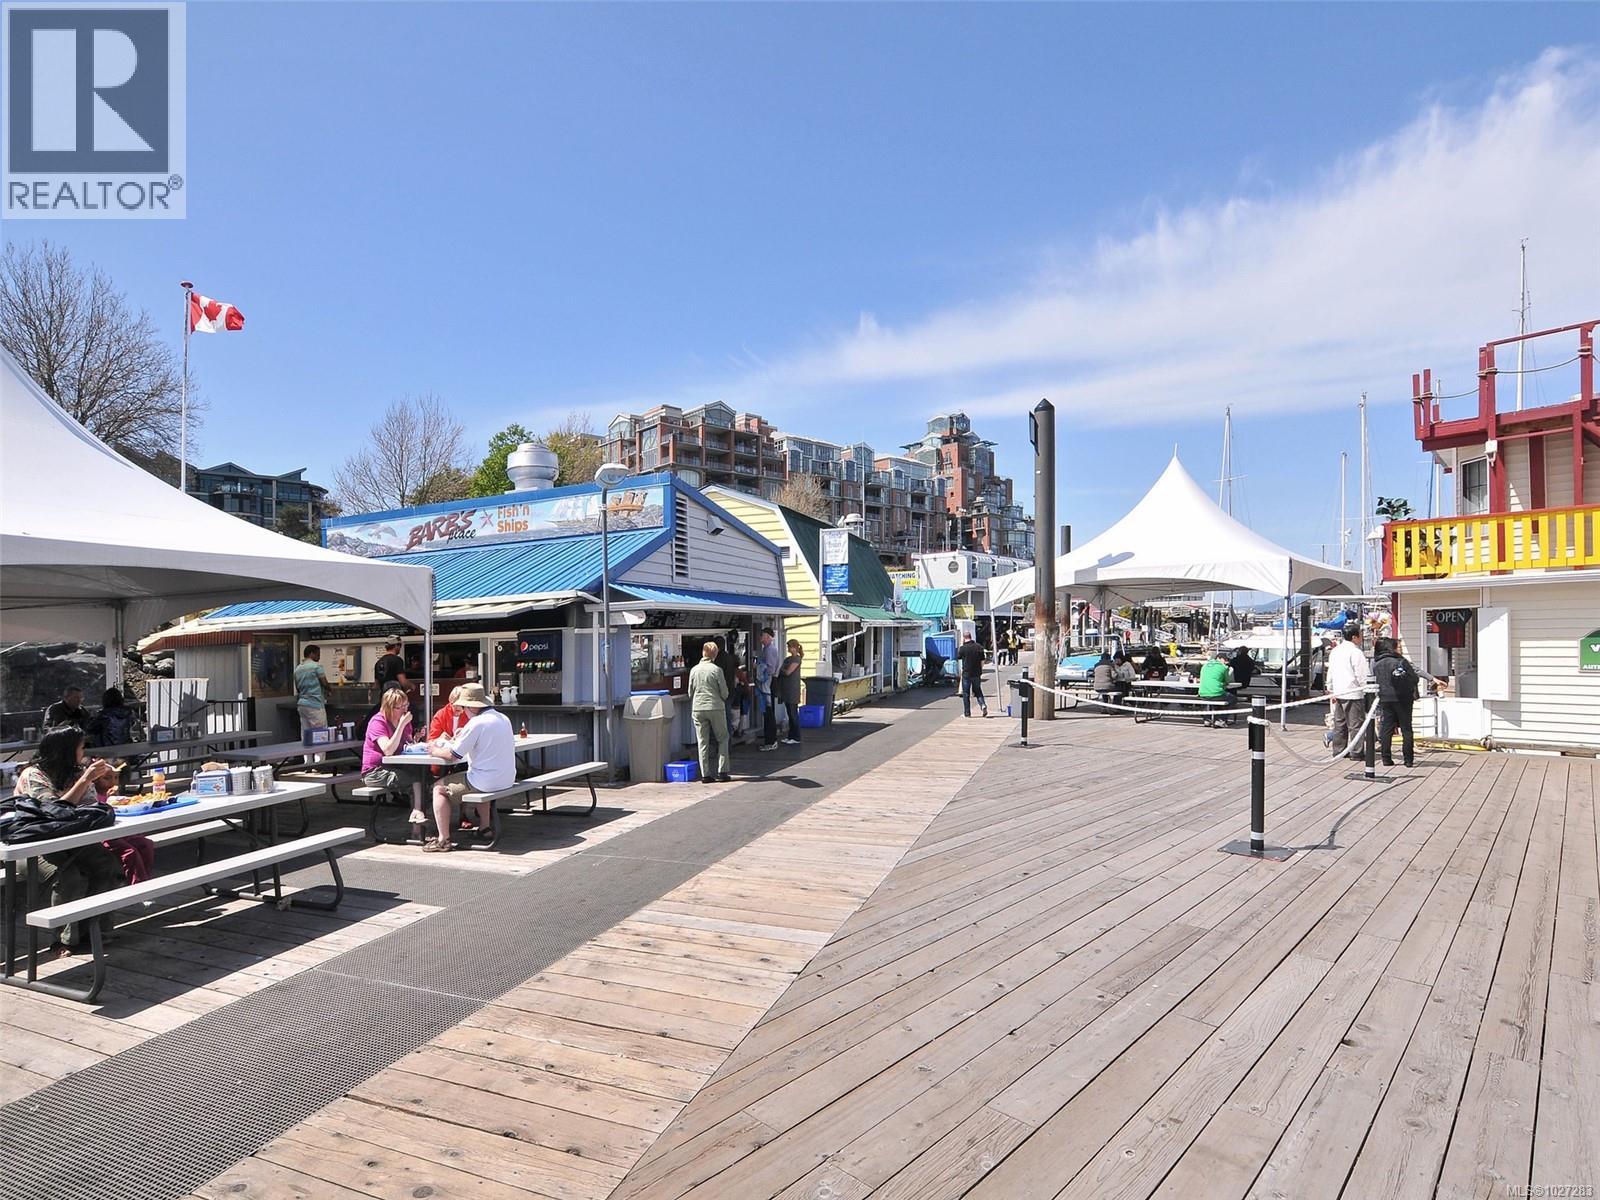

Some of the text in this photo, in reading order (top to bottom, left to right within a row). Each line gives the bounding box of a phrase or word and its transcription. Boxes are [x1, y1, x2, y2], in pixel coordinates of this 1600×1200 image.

[406, 508, 477, 551] BARB'S
[497, 519, 529, 534] Ships
[447, 528, 477, 544] place
[1436, 611, 1466, 623] OPEN
[529, 642, 549, 651] pepsi
